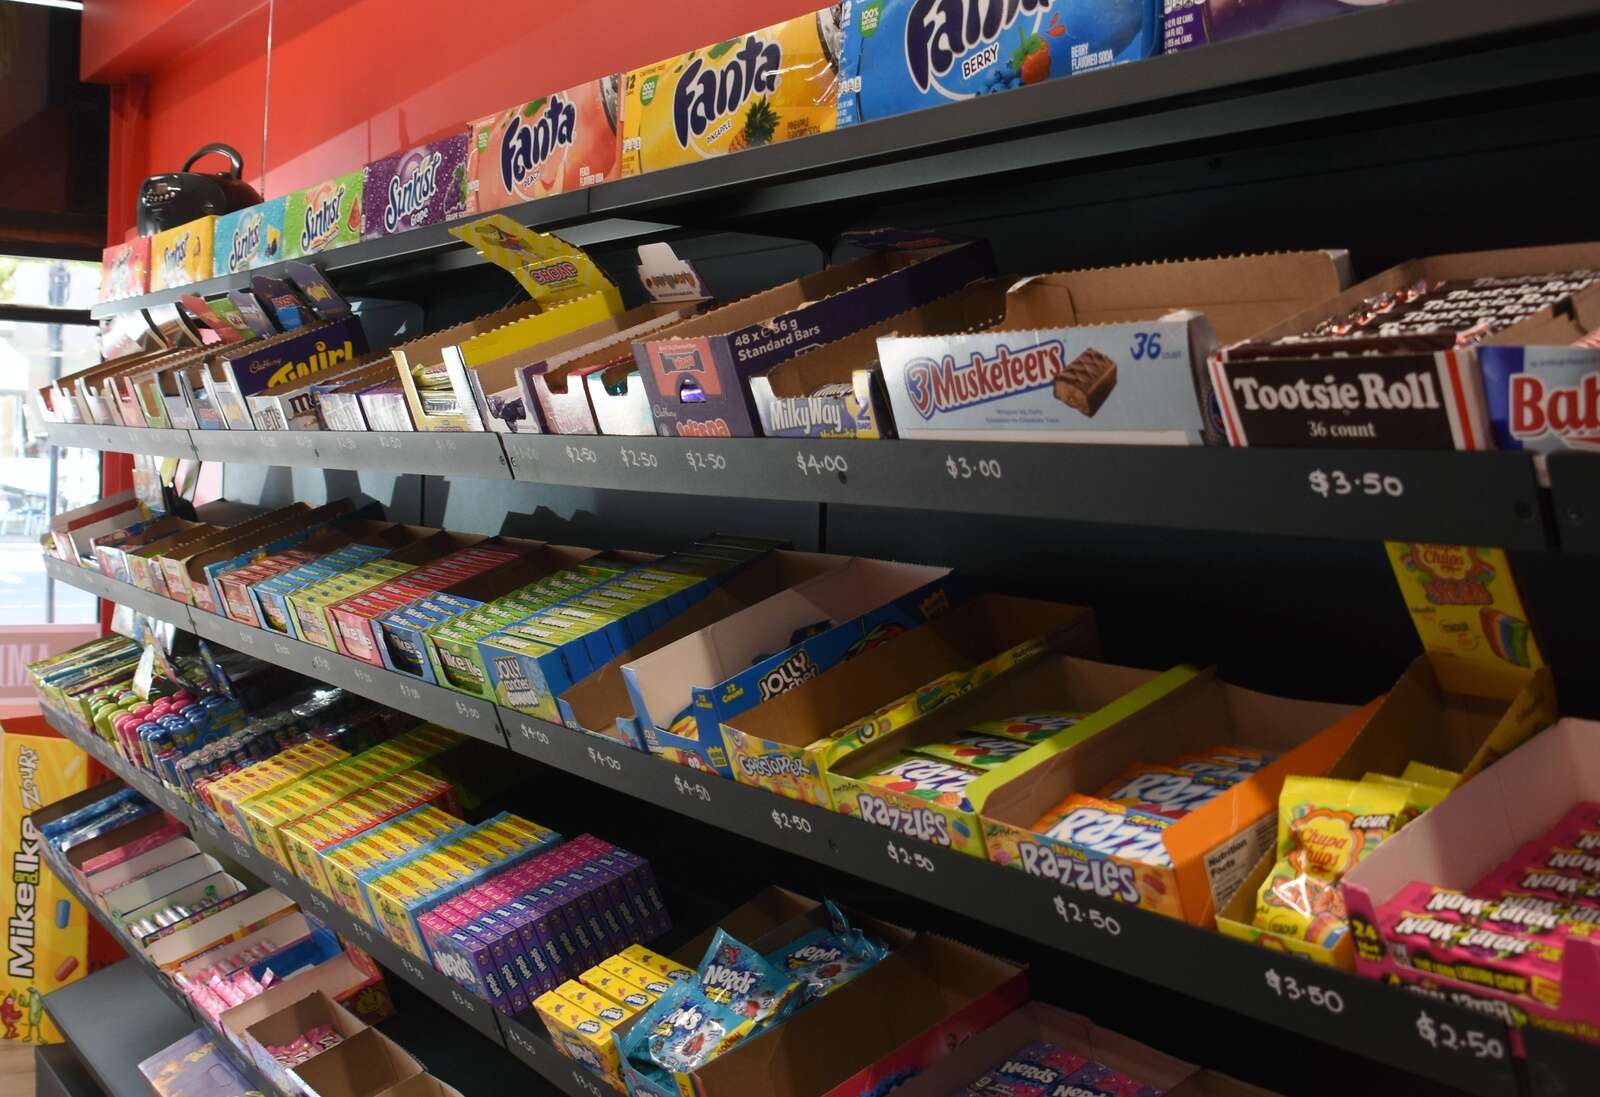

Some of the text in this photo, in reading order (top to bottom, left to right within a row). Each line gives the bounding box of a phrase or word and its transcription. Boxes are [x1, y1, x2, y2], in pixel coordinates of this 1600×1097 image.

[961, 44, 1000, 80] BERRY
[672, 34, 783, 150] Fanta
[500, 96, 577, 195] Fanta
[383, 150, 442, 233] Sunkist
[301, 185, 345, 252] Sunkist
[735, 333, 751, 348] 48
[737, 324, 821, 362] Standard Bars
[1129, 332, 1163, 361] 36
[908, 342, 1063, 409] 3 Musketeers
[1232, 371, 1441, 412] Tootsie Roll
[1306, 421, 1377, 438] 36 count
[945, 454, 1002, 480] $3.00
[1308, 469, 1405, 499] $3.50
[759, 651, 812, 703] JOLLY
[770, 807, 813, 835] $2.50
[857, 793, 952, 847] Razzles
[887, 840, 935, 873] $2.50
[1017, 840, 1141, 905] Razzles
[8, 882, 36, 979] Mike
[1052, 894, 1121, 936] $2.50
[702, 965, 756, 995] Nerds
[1263, 966, 1344, 1014] $3.50
[1415, 1009, 1505, 1059] $2.50
[1001, 1060, 1059, 1084] Nerds
